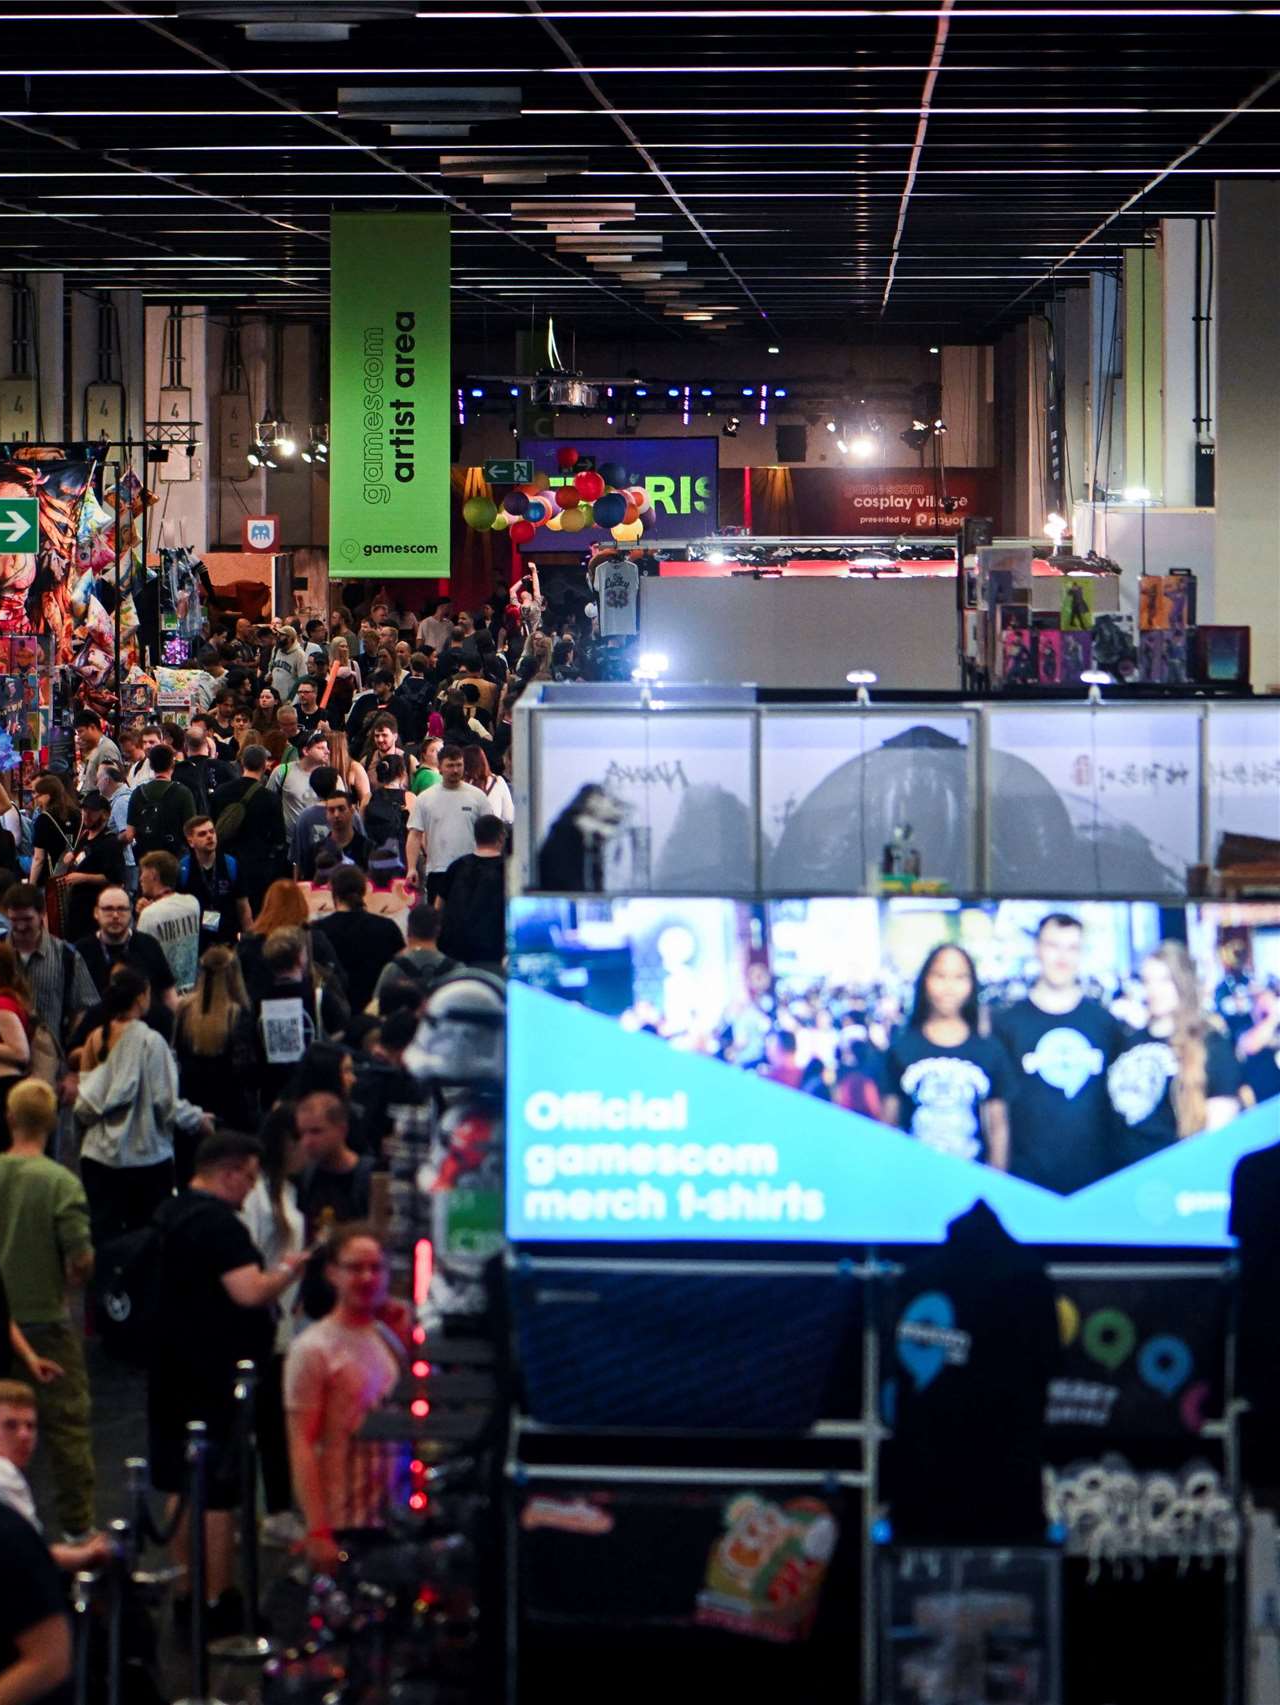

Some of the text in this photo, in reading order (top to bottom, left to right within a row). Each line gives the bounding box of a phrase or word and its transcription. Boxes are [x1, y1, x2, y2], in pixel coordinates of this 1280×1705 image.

[363, 327, 391, 504] gamescom
[390, 311, 415, 483] artist area
[853, 495, 912, 510] cosplay
[363, 544, 438, 558] gamescom
[524, 1090, 688, 1131] Official
[524, 1142, 779, 1186] gamescom
[524, 1181, 667, 1222] merch
[677, 1181, 826, 1222] t-shirts
